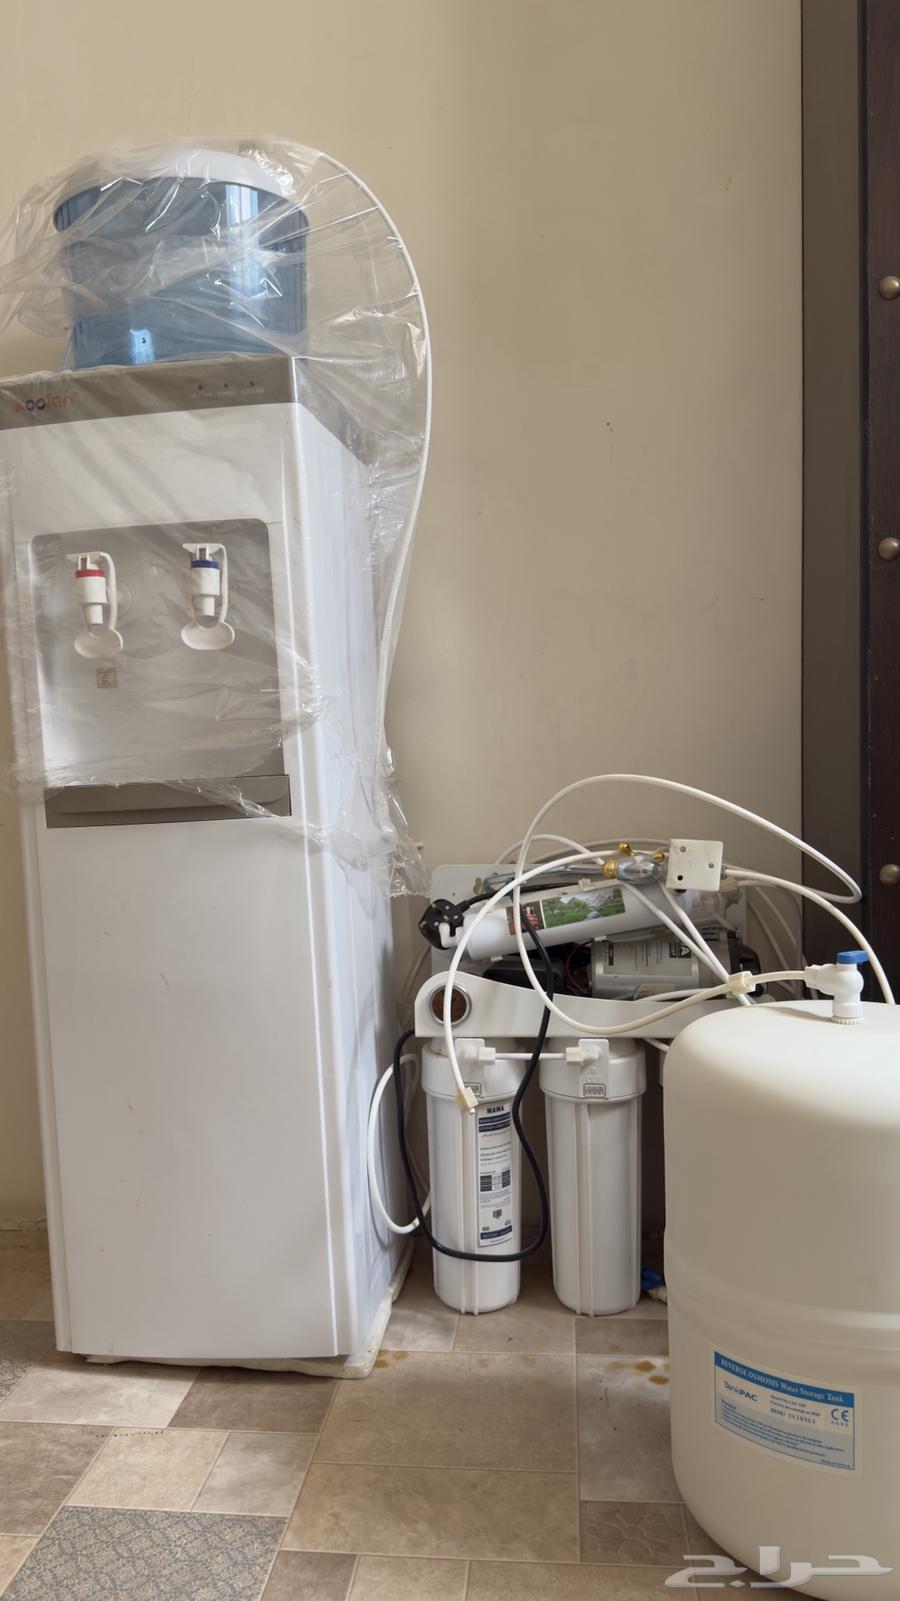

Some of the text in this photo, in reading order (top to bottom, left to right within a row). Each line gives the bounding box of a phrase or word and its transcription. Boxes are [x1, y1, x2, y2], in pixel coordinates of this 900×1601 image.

[720, 1358, 746, 1376] REVERSE
[748, 1371, 779, 1388] OSMOSIS
[780, 1382, 799, 1394] Water
[800, 1387, 825, 1402] Storage
[827, 1392, 844, 1402] Tank
